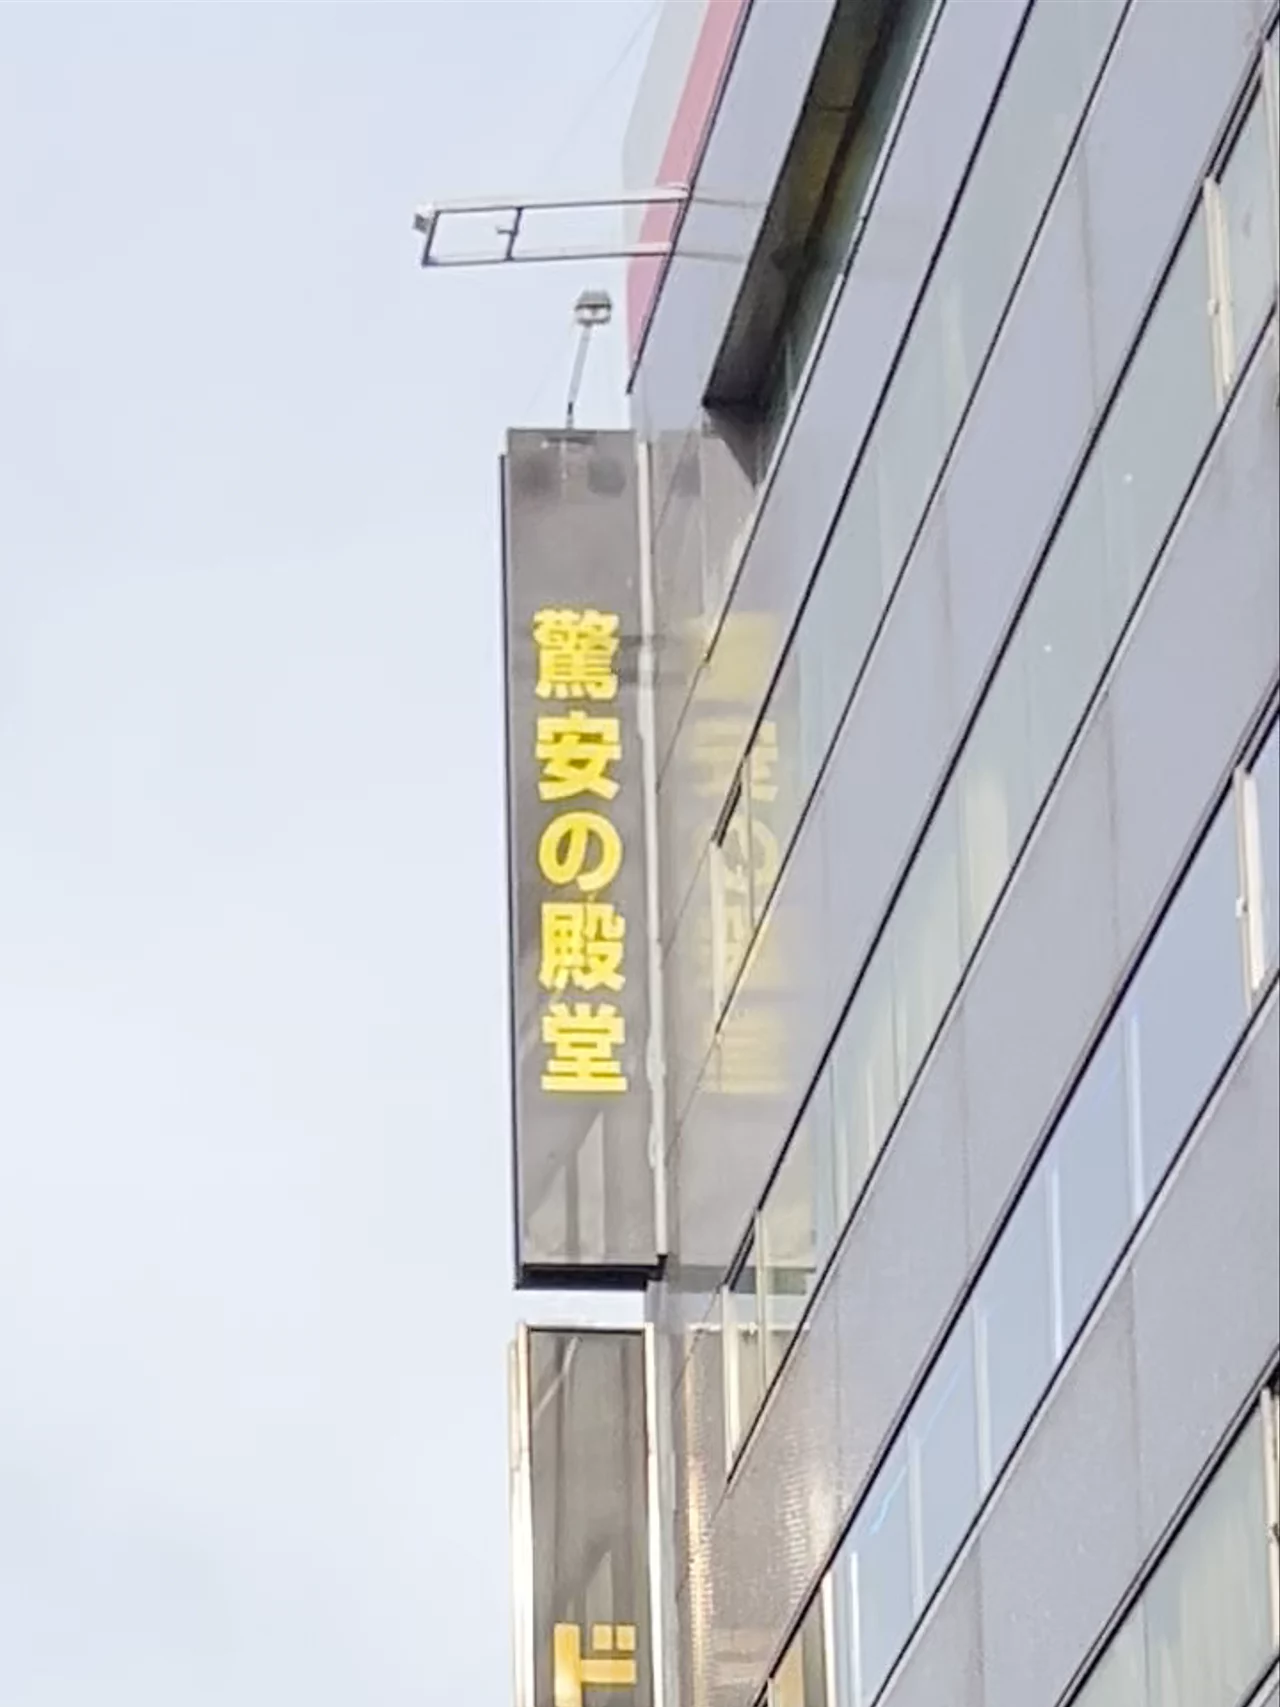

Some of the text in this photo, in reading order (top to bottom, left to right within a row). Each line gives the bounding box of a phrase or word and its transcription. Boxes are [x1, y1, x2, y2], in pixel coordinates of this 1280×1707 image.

[533, 608, 627, 1095] 驚安の殿堂
